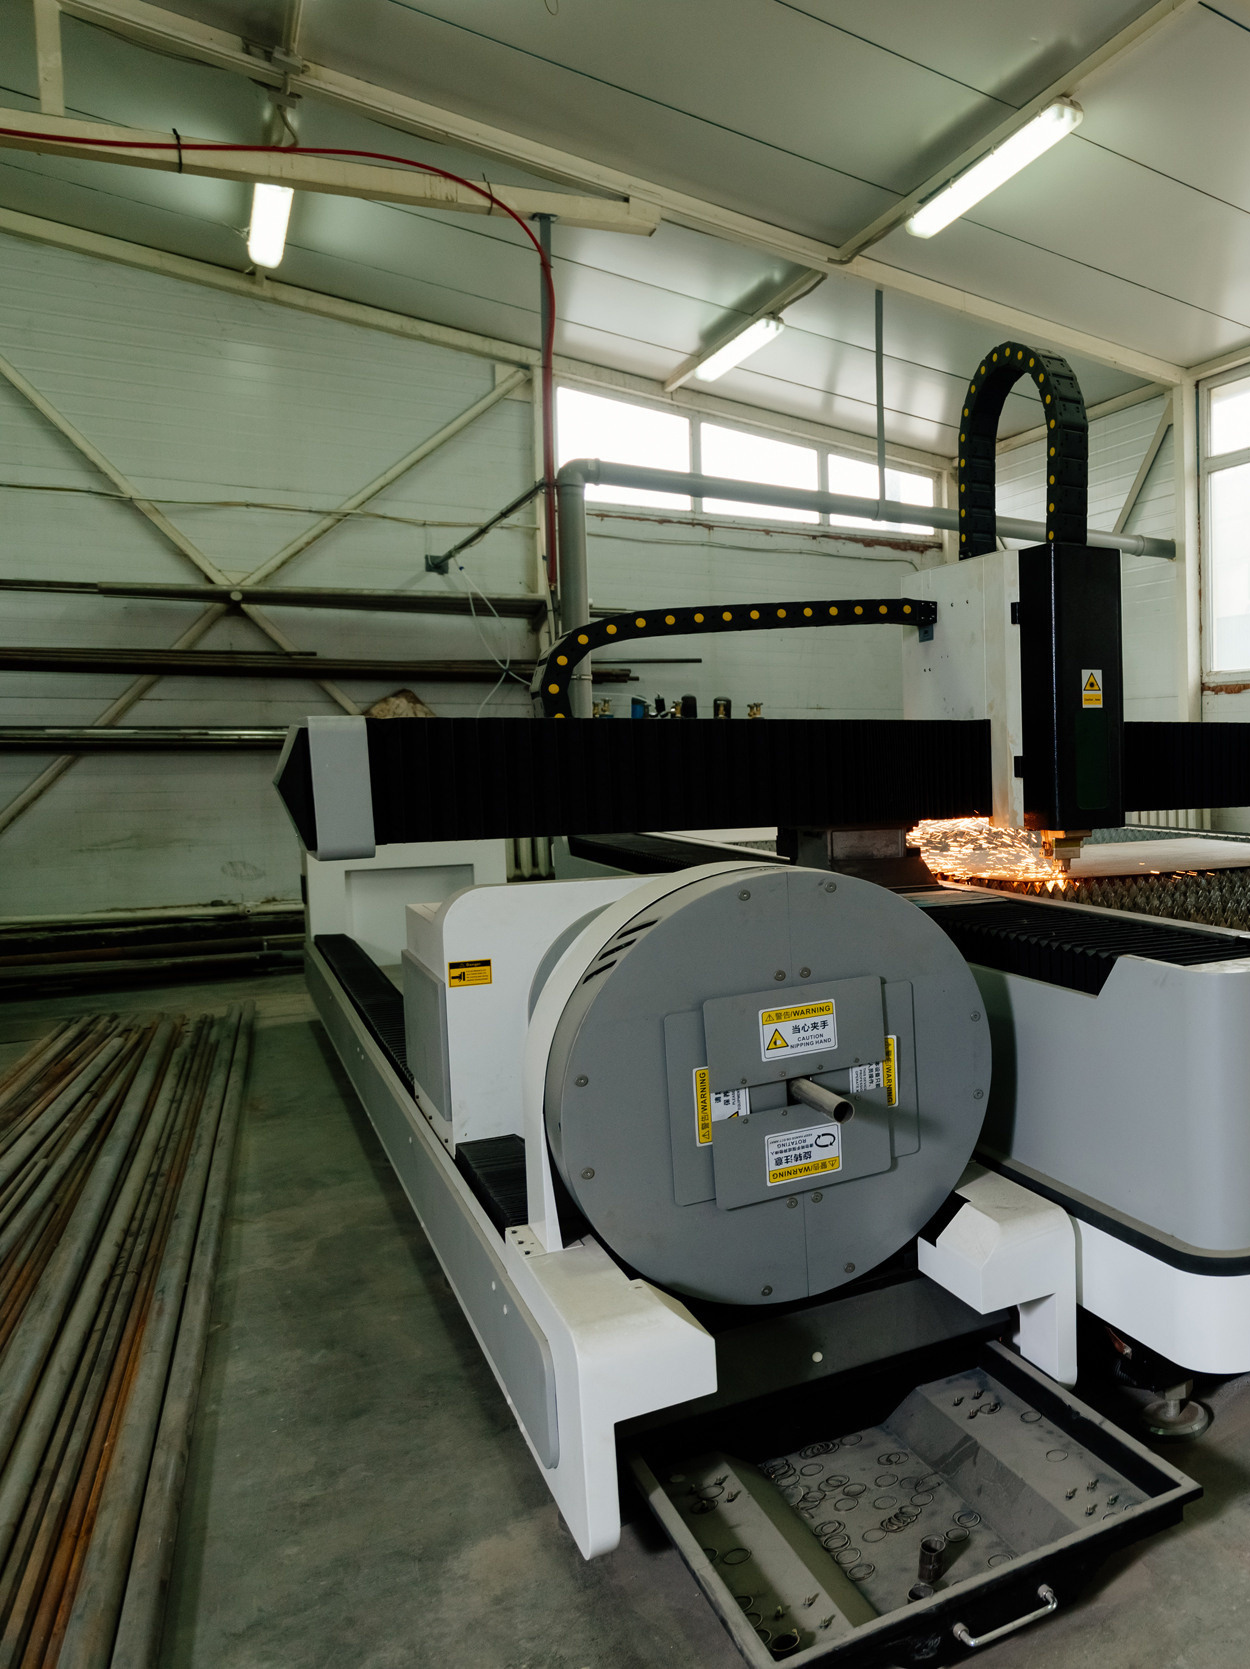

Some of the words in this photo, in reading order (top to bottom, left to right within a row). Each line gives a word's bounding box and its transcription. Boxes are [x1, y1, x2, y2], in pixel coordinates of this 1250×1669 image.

[792, 1019, 829, 1034] 当心夹手
[790, 1040, 814, 1049] NIPPING
[815, 1037, 832, 1045] HAND
[797, 1033, 824, 1042] CAUTION
[777, 1139, 807, 1149] ROTATING
[775, 1151, 812, 1166] 旋转注意
